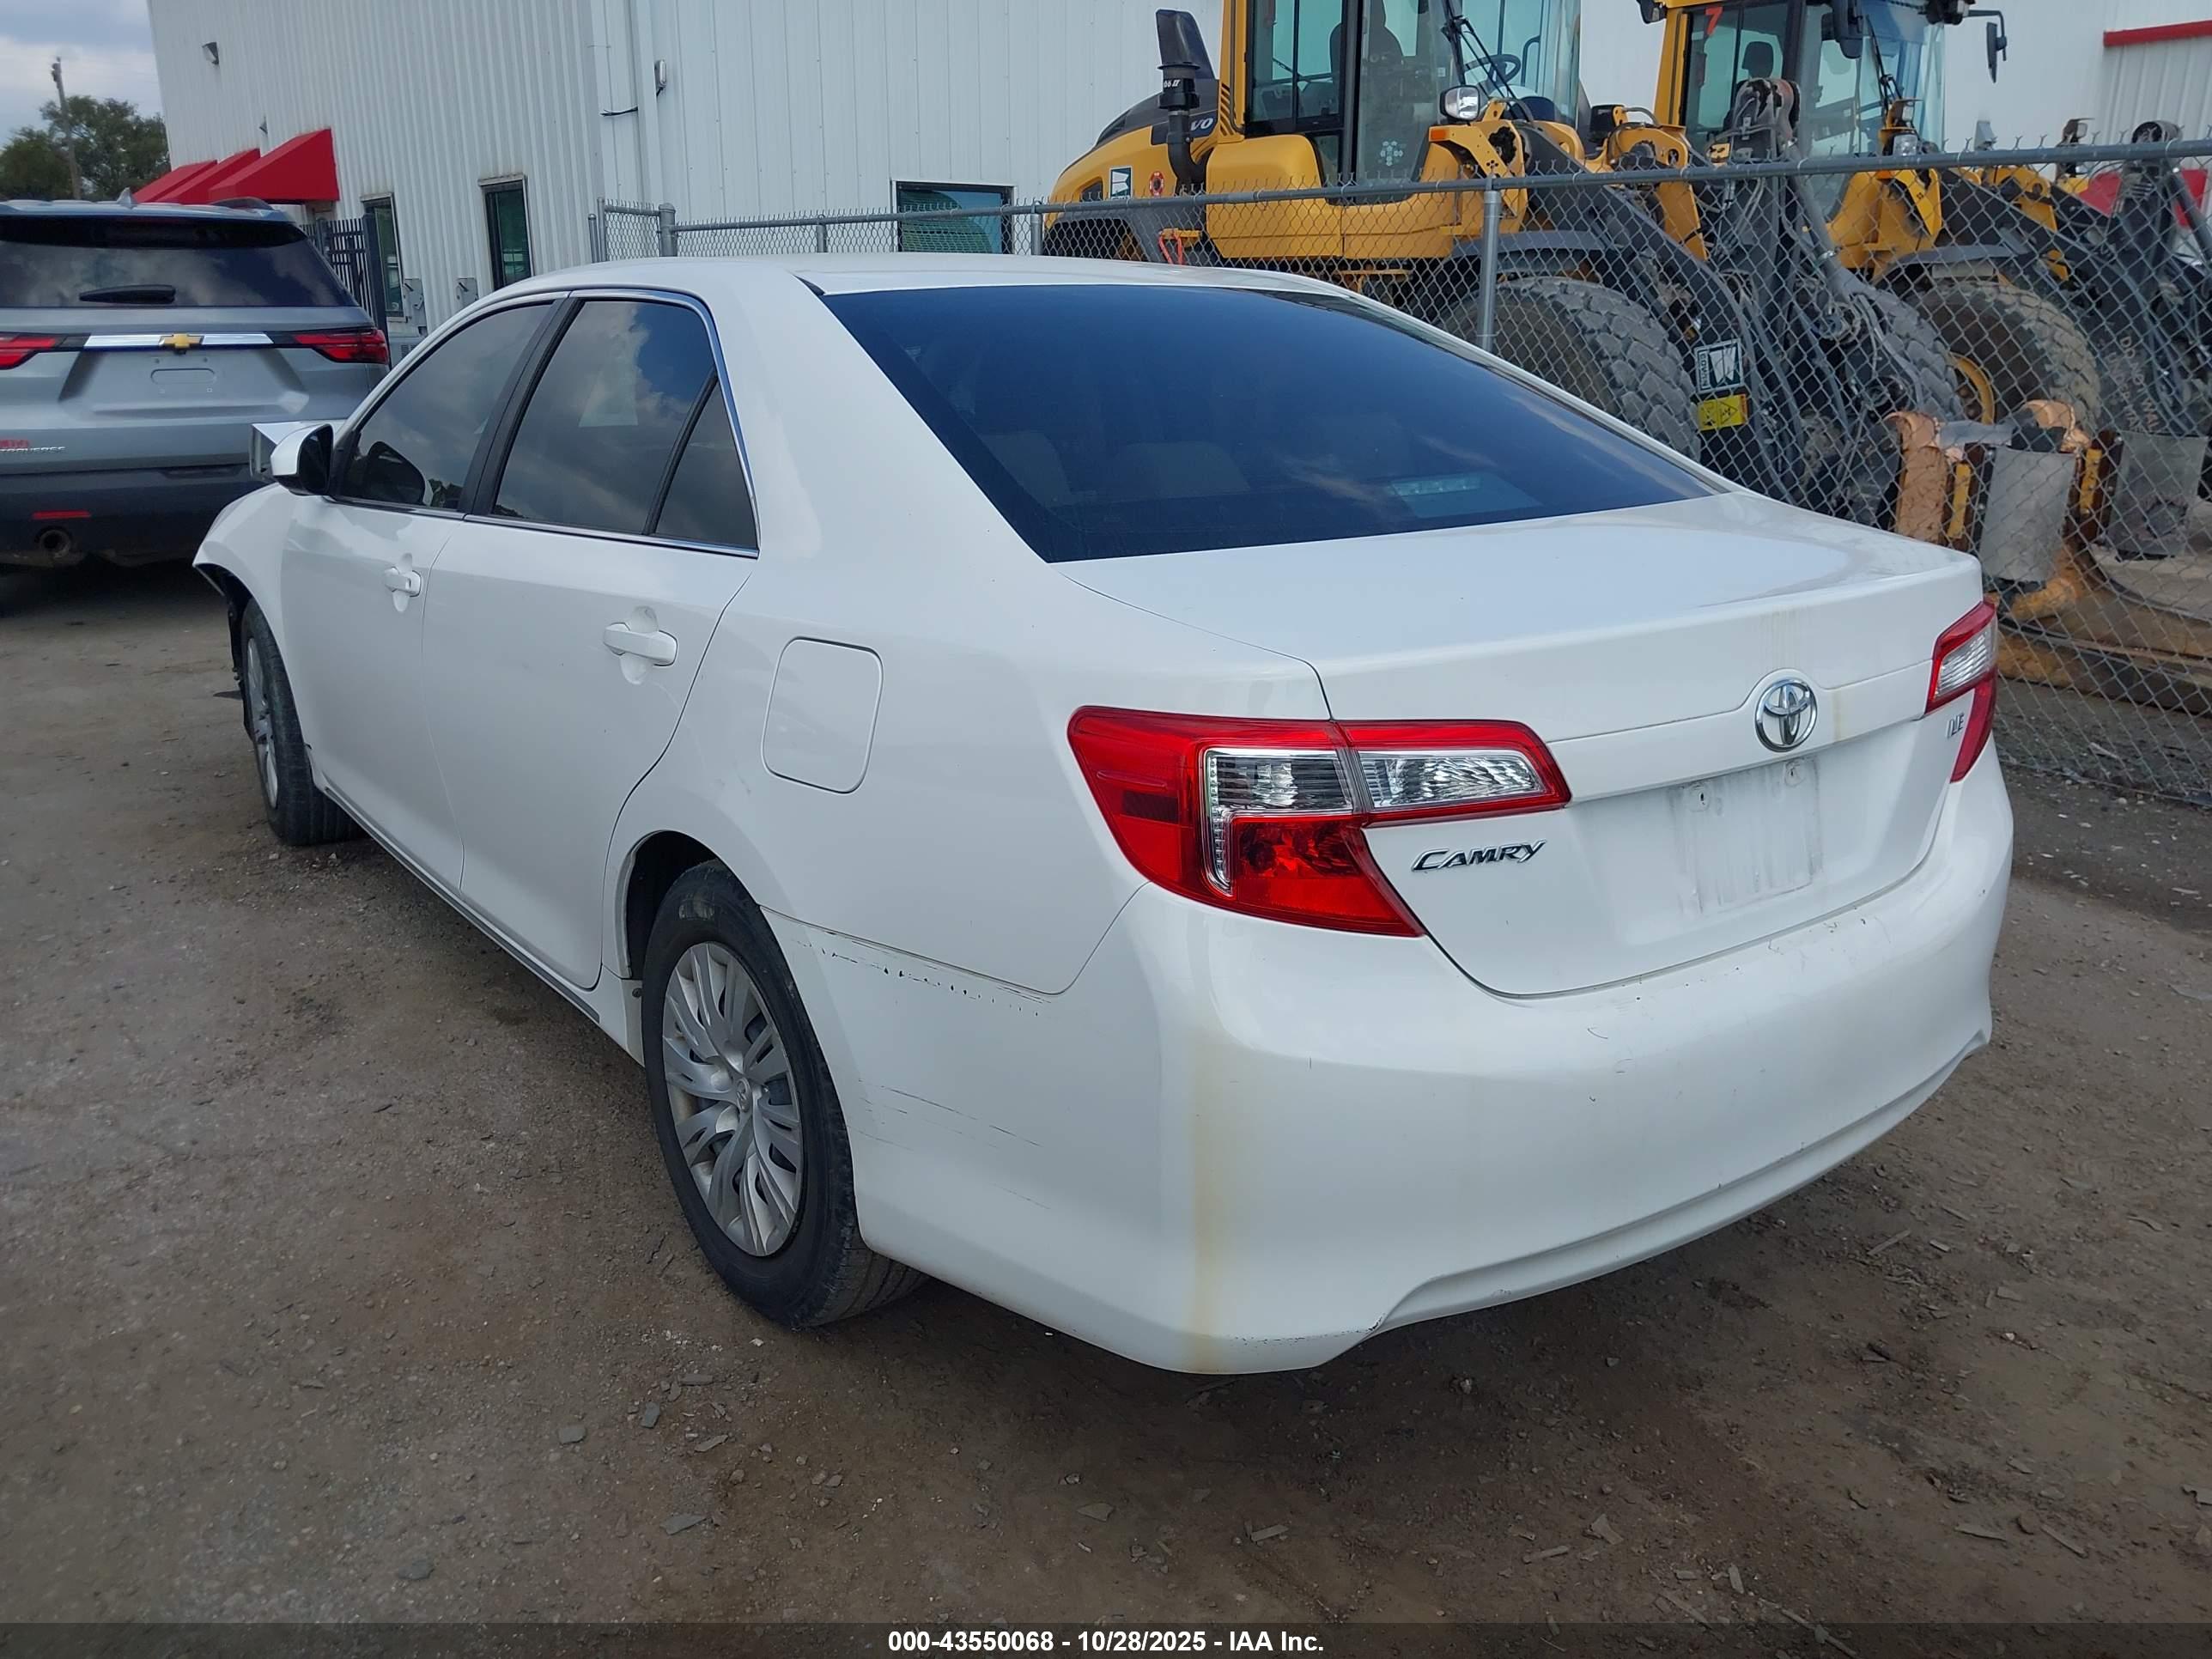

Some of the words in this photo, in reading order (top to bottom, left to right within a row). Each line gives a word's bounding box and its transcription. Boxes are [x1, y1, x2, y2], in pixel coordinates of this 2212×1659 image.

[1705, 5, 1724, 37] 7
[1946, 713, 1965, 738] LE
[1411, 839, 1547, 872] CAMRY
